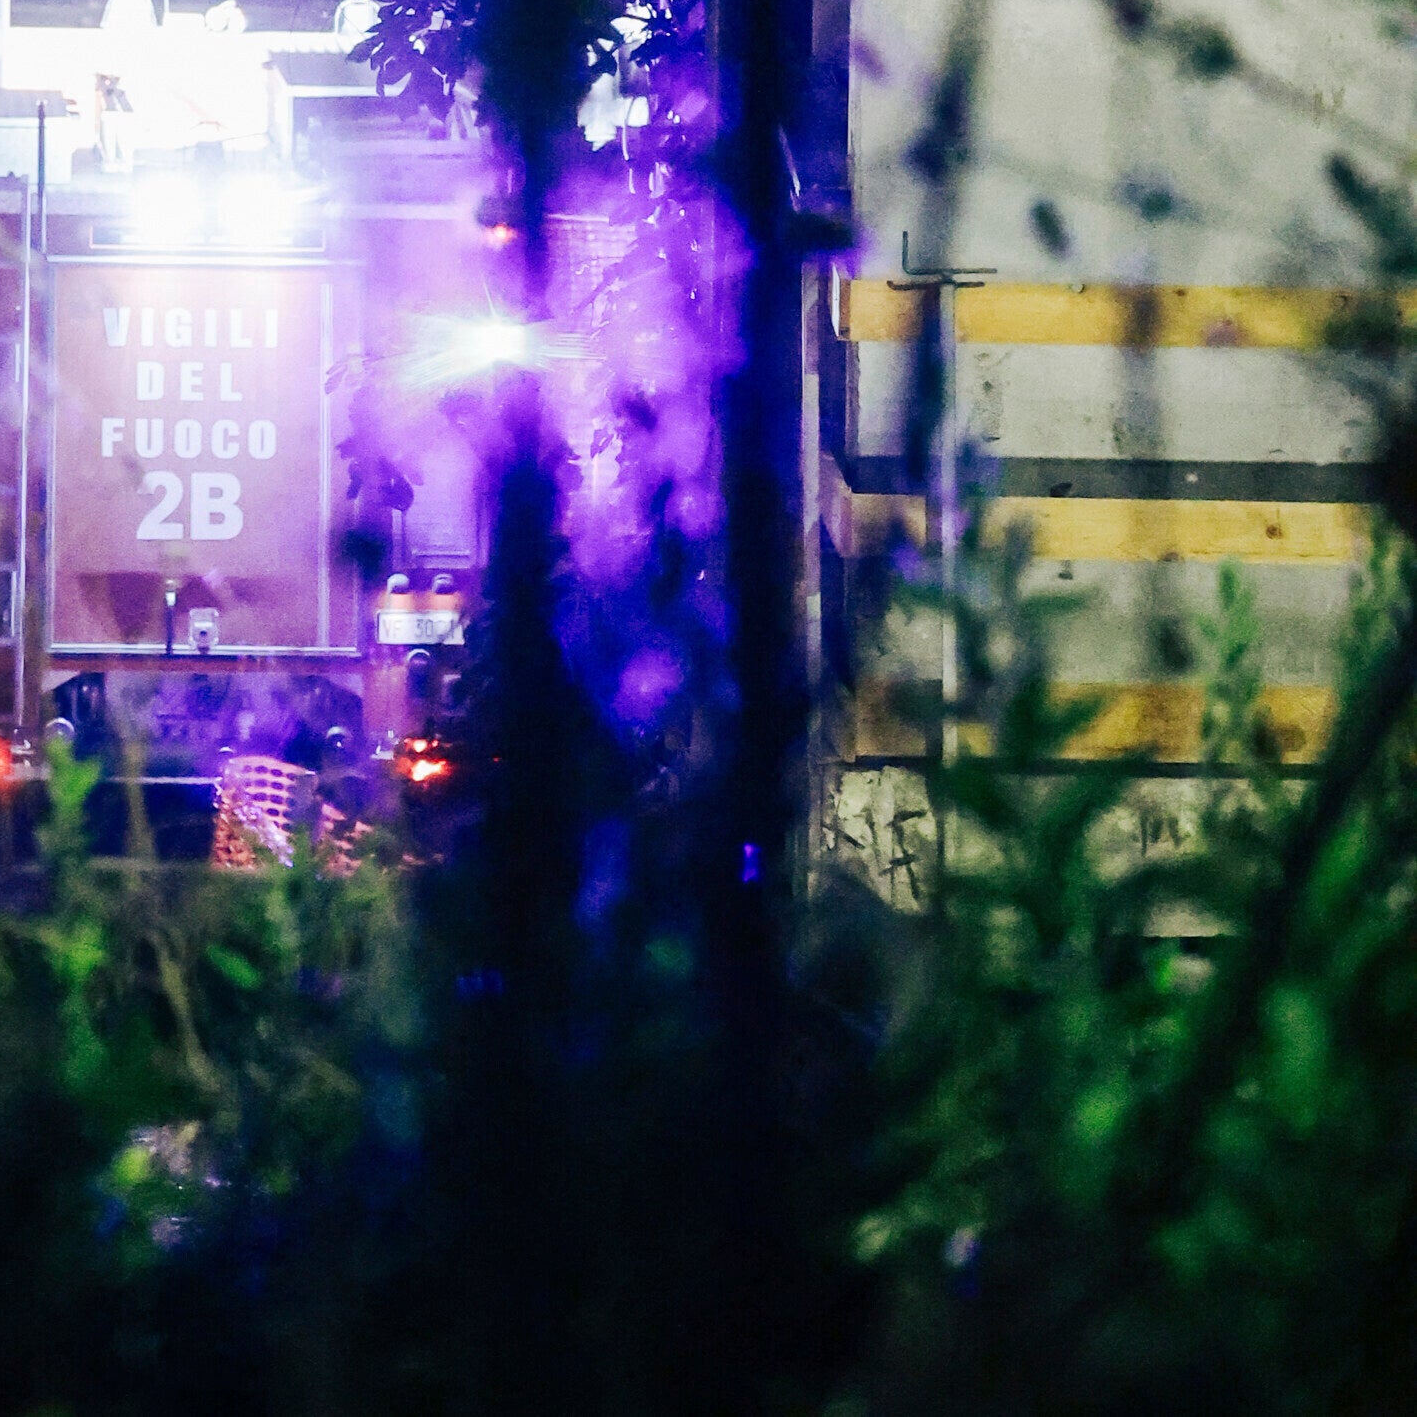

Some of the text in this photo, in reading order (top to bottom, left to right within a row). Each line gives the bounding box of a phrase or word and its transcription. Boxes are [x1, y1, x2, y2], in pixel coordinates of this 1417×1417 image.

[102, 307, 279, 349] VIGILI
[136, 361, 243, 402] DEL
[101, 418, 277, 460] FUOCO
[136, 471, 244, 541] 2B
